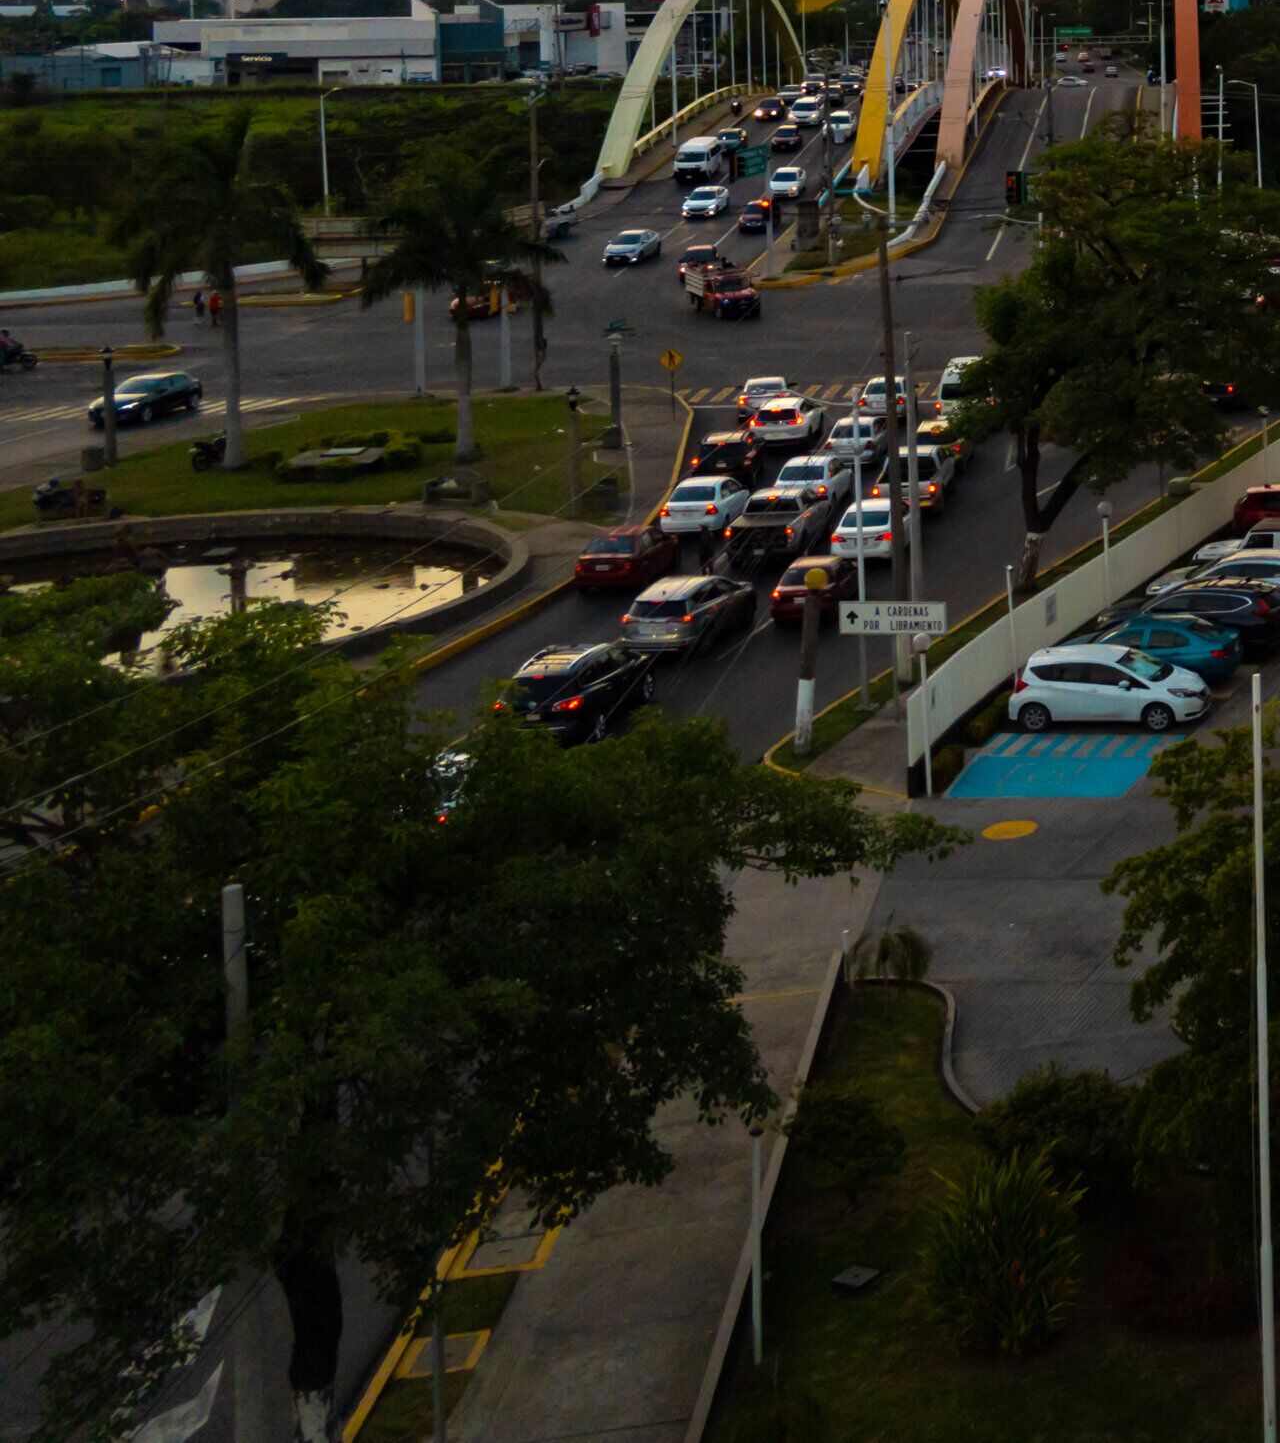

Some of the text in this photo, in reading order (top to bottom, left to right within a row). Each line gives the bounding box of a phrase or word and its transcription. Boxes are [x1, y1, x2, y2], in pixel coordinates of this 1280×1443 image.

[875, 606, 929, 617] A CARDENAS
[863, 620, 942, 631] POR LIBRAMIENTO
